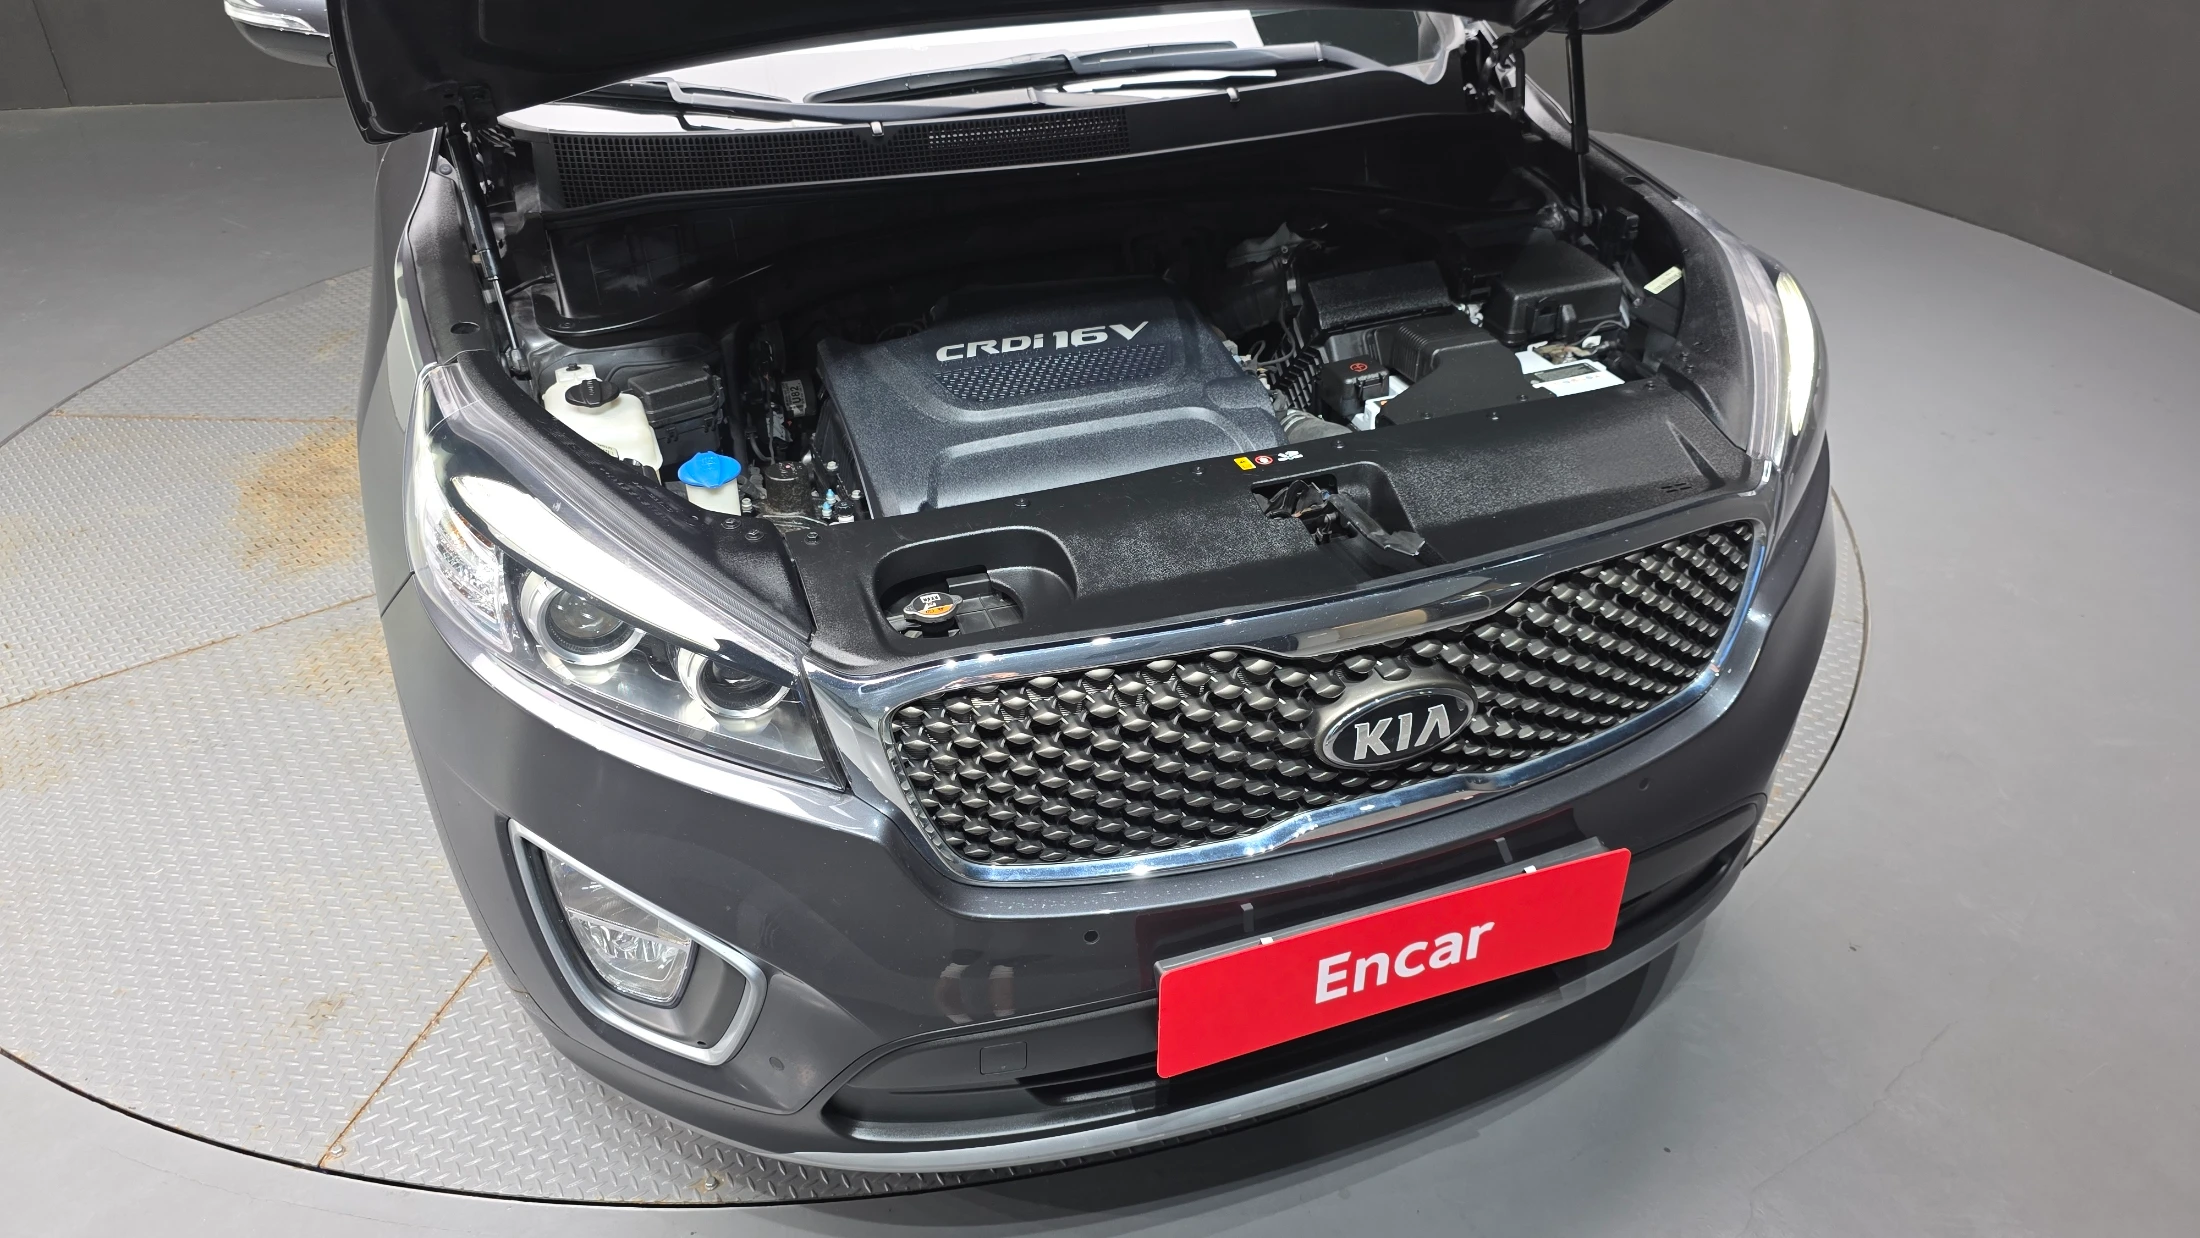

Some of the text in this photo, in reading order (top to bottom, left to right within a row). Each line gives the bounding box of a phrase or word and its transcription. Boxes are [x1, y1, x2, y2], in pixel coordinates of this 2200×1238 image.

[936, 321, 1149, 362] CRDi 16V
[1354, 704, 1451, 760] KIA
[1315, 921, 1495, 1004] Encar
